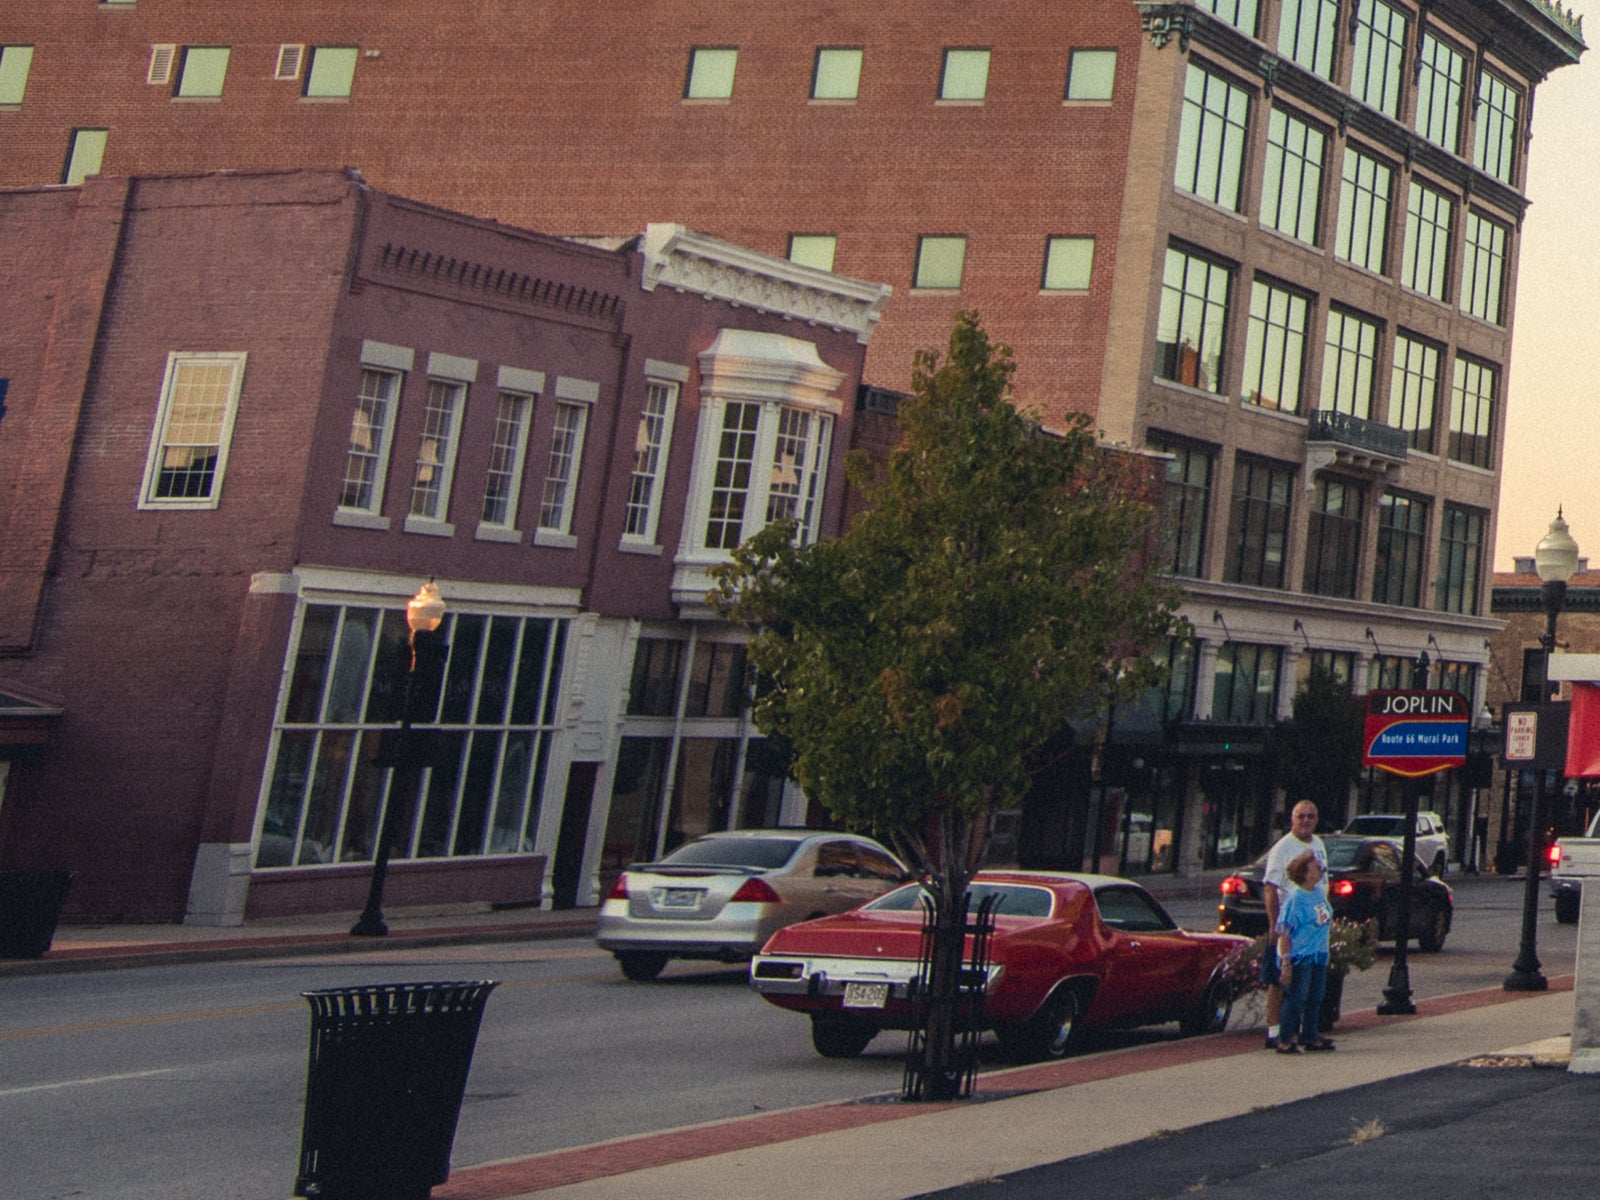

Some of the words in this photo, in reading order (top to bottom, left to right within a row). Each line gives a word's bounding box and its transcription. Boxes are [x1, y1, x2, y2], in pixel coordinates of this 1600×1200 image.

[1382, 696, 1453, 714] JOPLIN
[1382, 734, 1403, 743] Route
[1406, 734, 1415, 743] 66
[1418, 734, 1439, 743] Mural
[1442, 734, 1459, 743] Park
